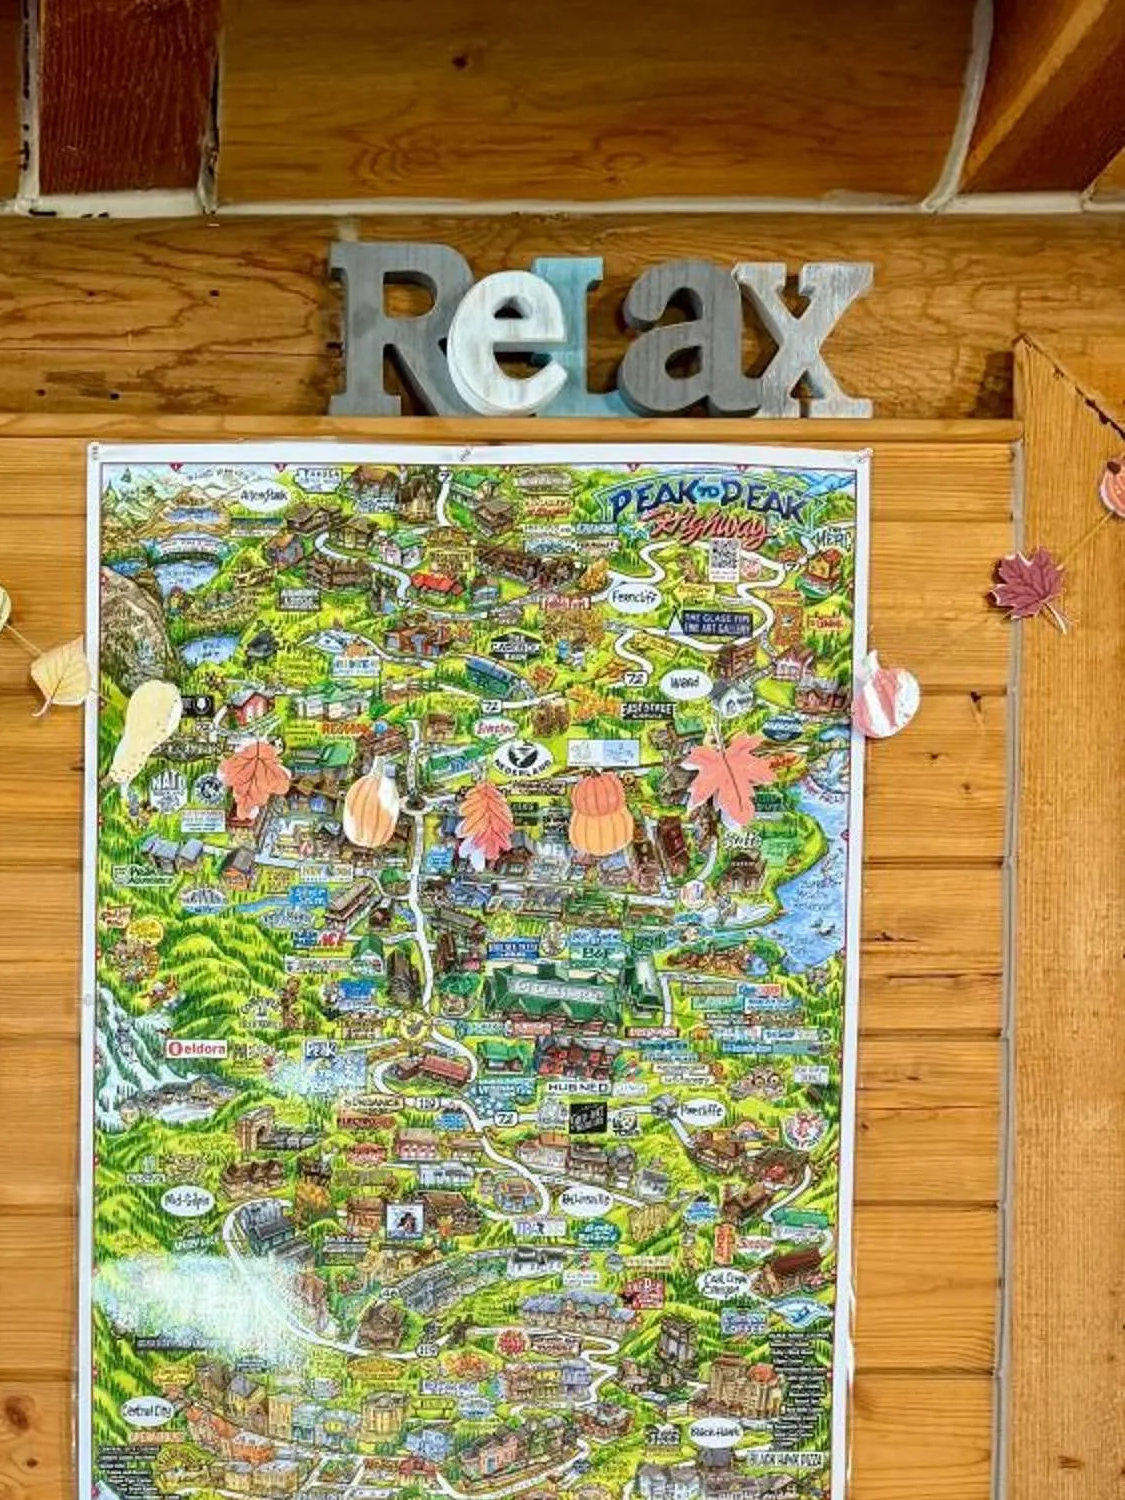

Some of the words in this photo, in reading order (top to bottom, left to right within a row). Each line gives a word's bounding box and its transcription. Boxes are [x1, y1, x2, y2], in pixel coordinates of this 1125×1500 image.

[611, 479, 699, 519] PEAK
[721, 479, 808, 523] PEAK
[642, 505, 773, 551] Highway
[184, 1043, 226, 1055] eldora
